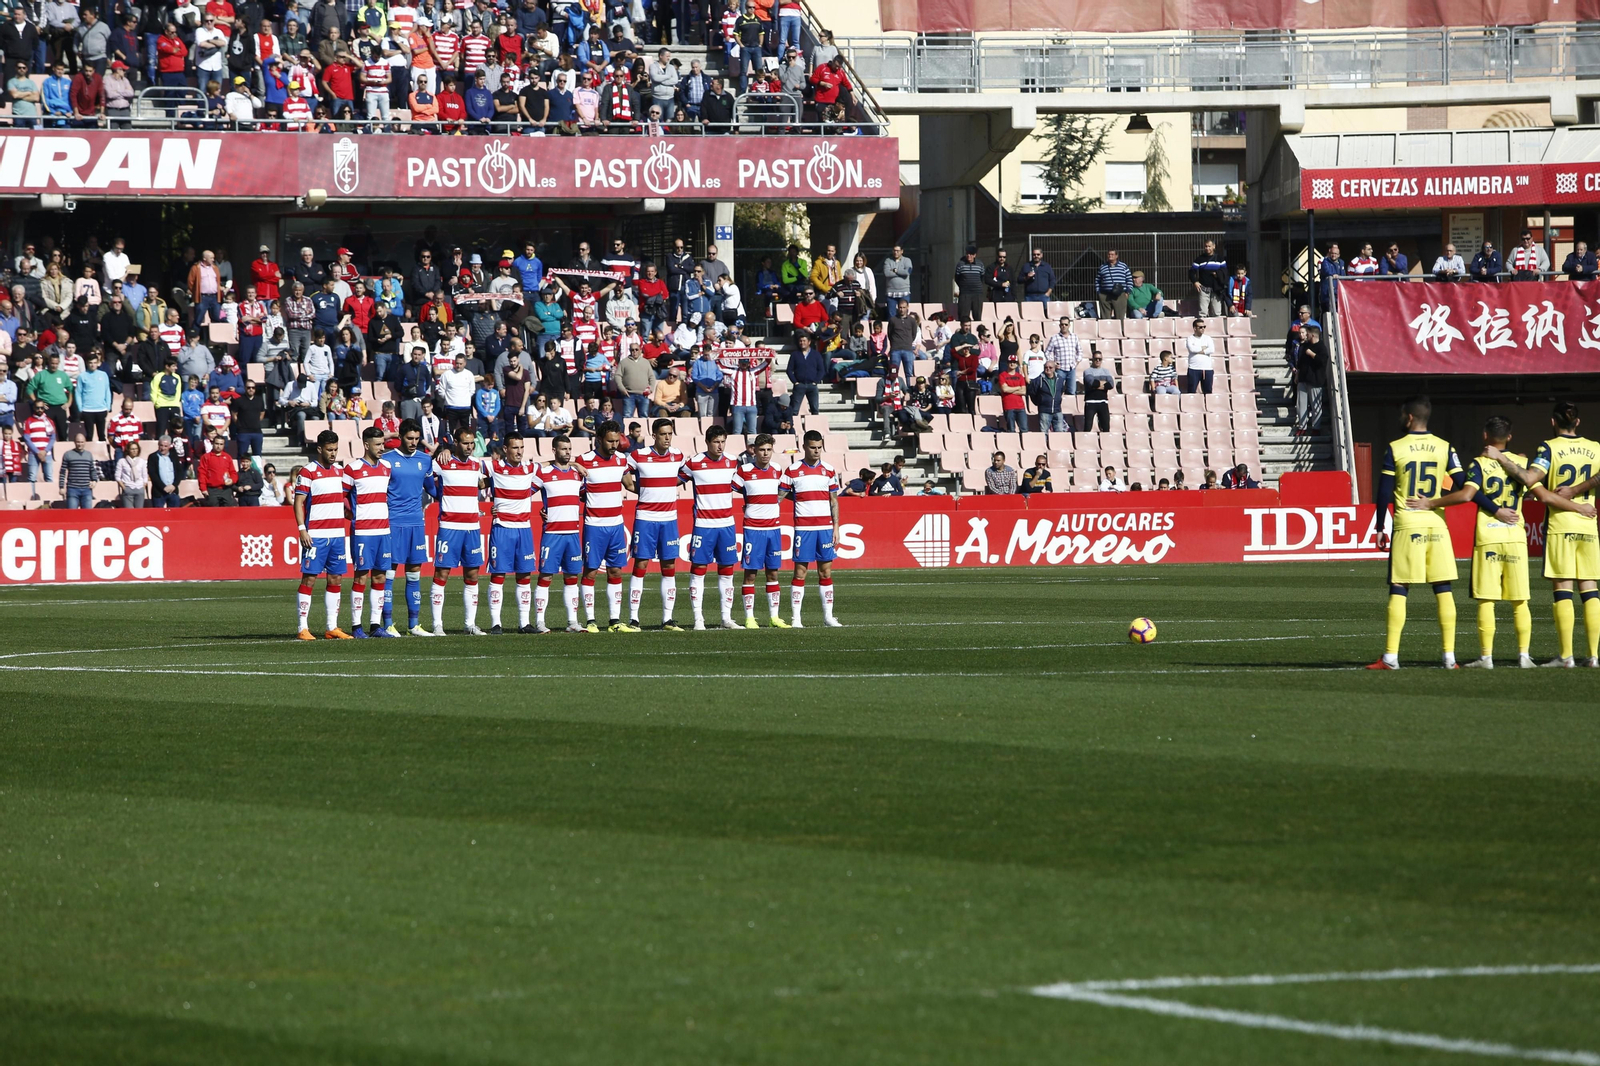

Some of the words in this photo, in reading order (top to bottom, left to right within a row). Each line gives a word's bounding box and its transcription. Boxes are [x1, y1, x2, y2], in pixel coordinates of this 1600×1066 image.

[0, 135, 222, 189] IRAN
[1340, 178, 1418, 197] CERVEZAS
[1424, 175, 1513, 196] ALHAMBRA
[1515, 175, 1529, 186] SIN
[1409, 444, 1436, 453] ALAIN
[1557, 450, 1568, 459] M.
[1569, 446, 1596, 460] MATEU
[1404, 460, 1438, 498] 15
[1556, 463, 1592, 502] 21
[1486, 476, 1519, 511] 23
[1055, 512, 1175, 532] AUTOCARES
[437, 540, 449, 554] 16
[691, 535, 703, 548] 15
[745, 542, 752, 555] 9
[795, 535, 801, 548] 3
[1004, 518, 1176, 565] Moreno
[358, 543, 365, 557] 7
[490, 546, 497, 559] 8
[541, 546, 550, 559] 11
